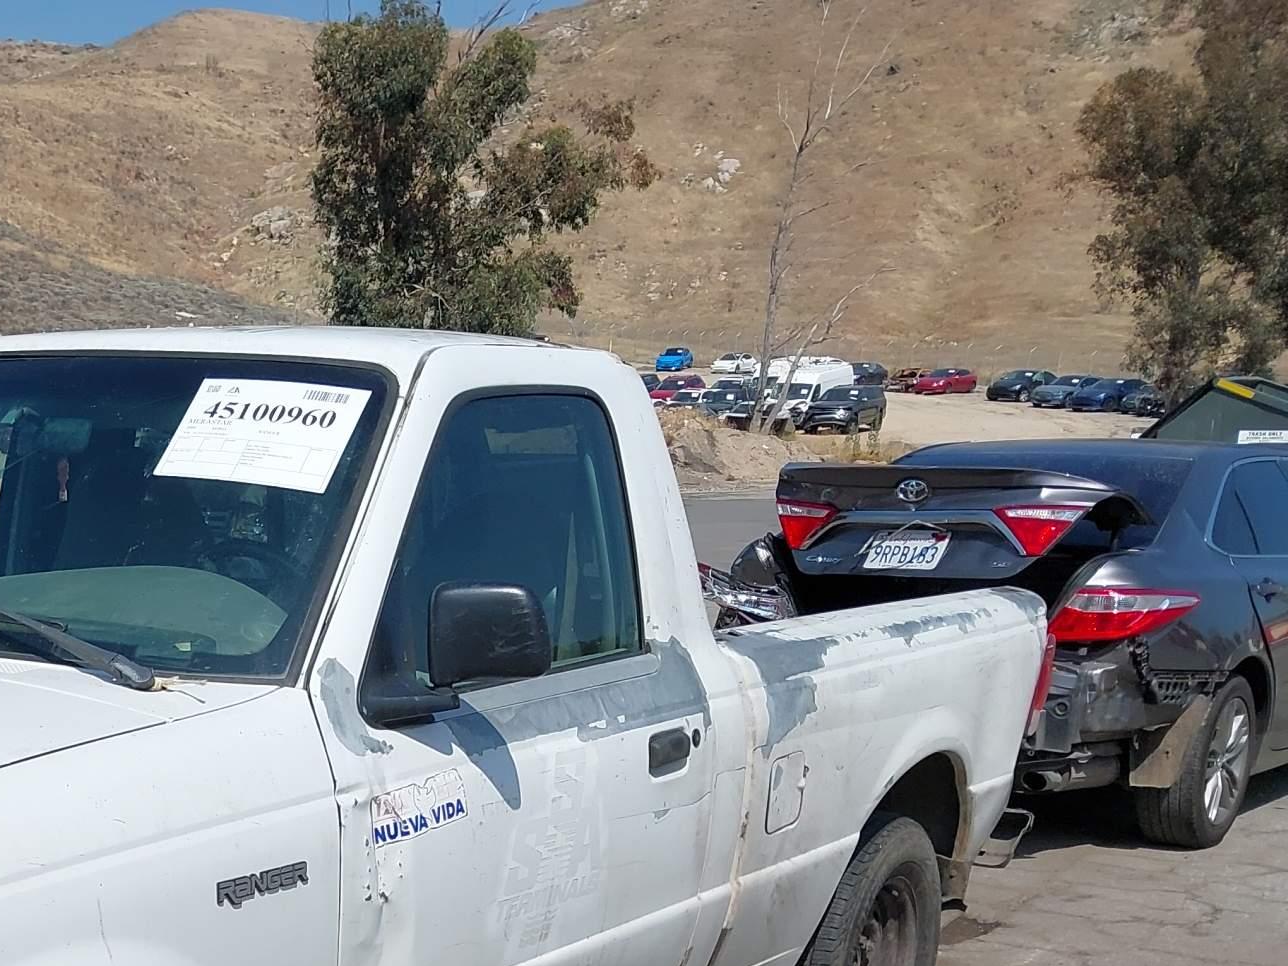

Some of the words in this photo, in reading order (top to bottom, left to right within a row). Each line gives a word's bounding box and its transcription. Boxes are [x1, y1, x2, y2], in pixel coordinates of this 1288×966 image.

[203, 401, 338, 429] 45100960
[373, 813, 430, 845] NUEVA
[431, 798, 466, 825] VIDA
[216, 860, 310, 910] RANGER
